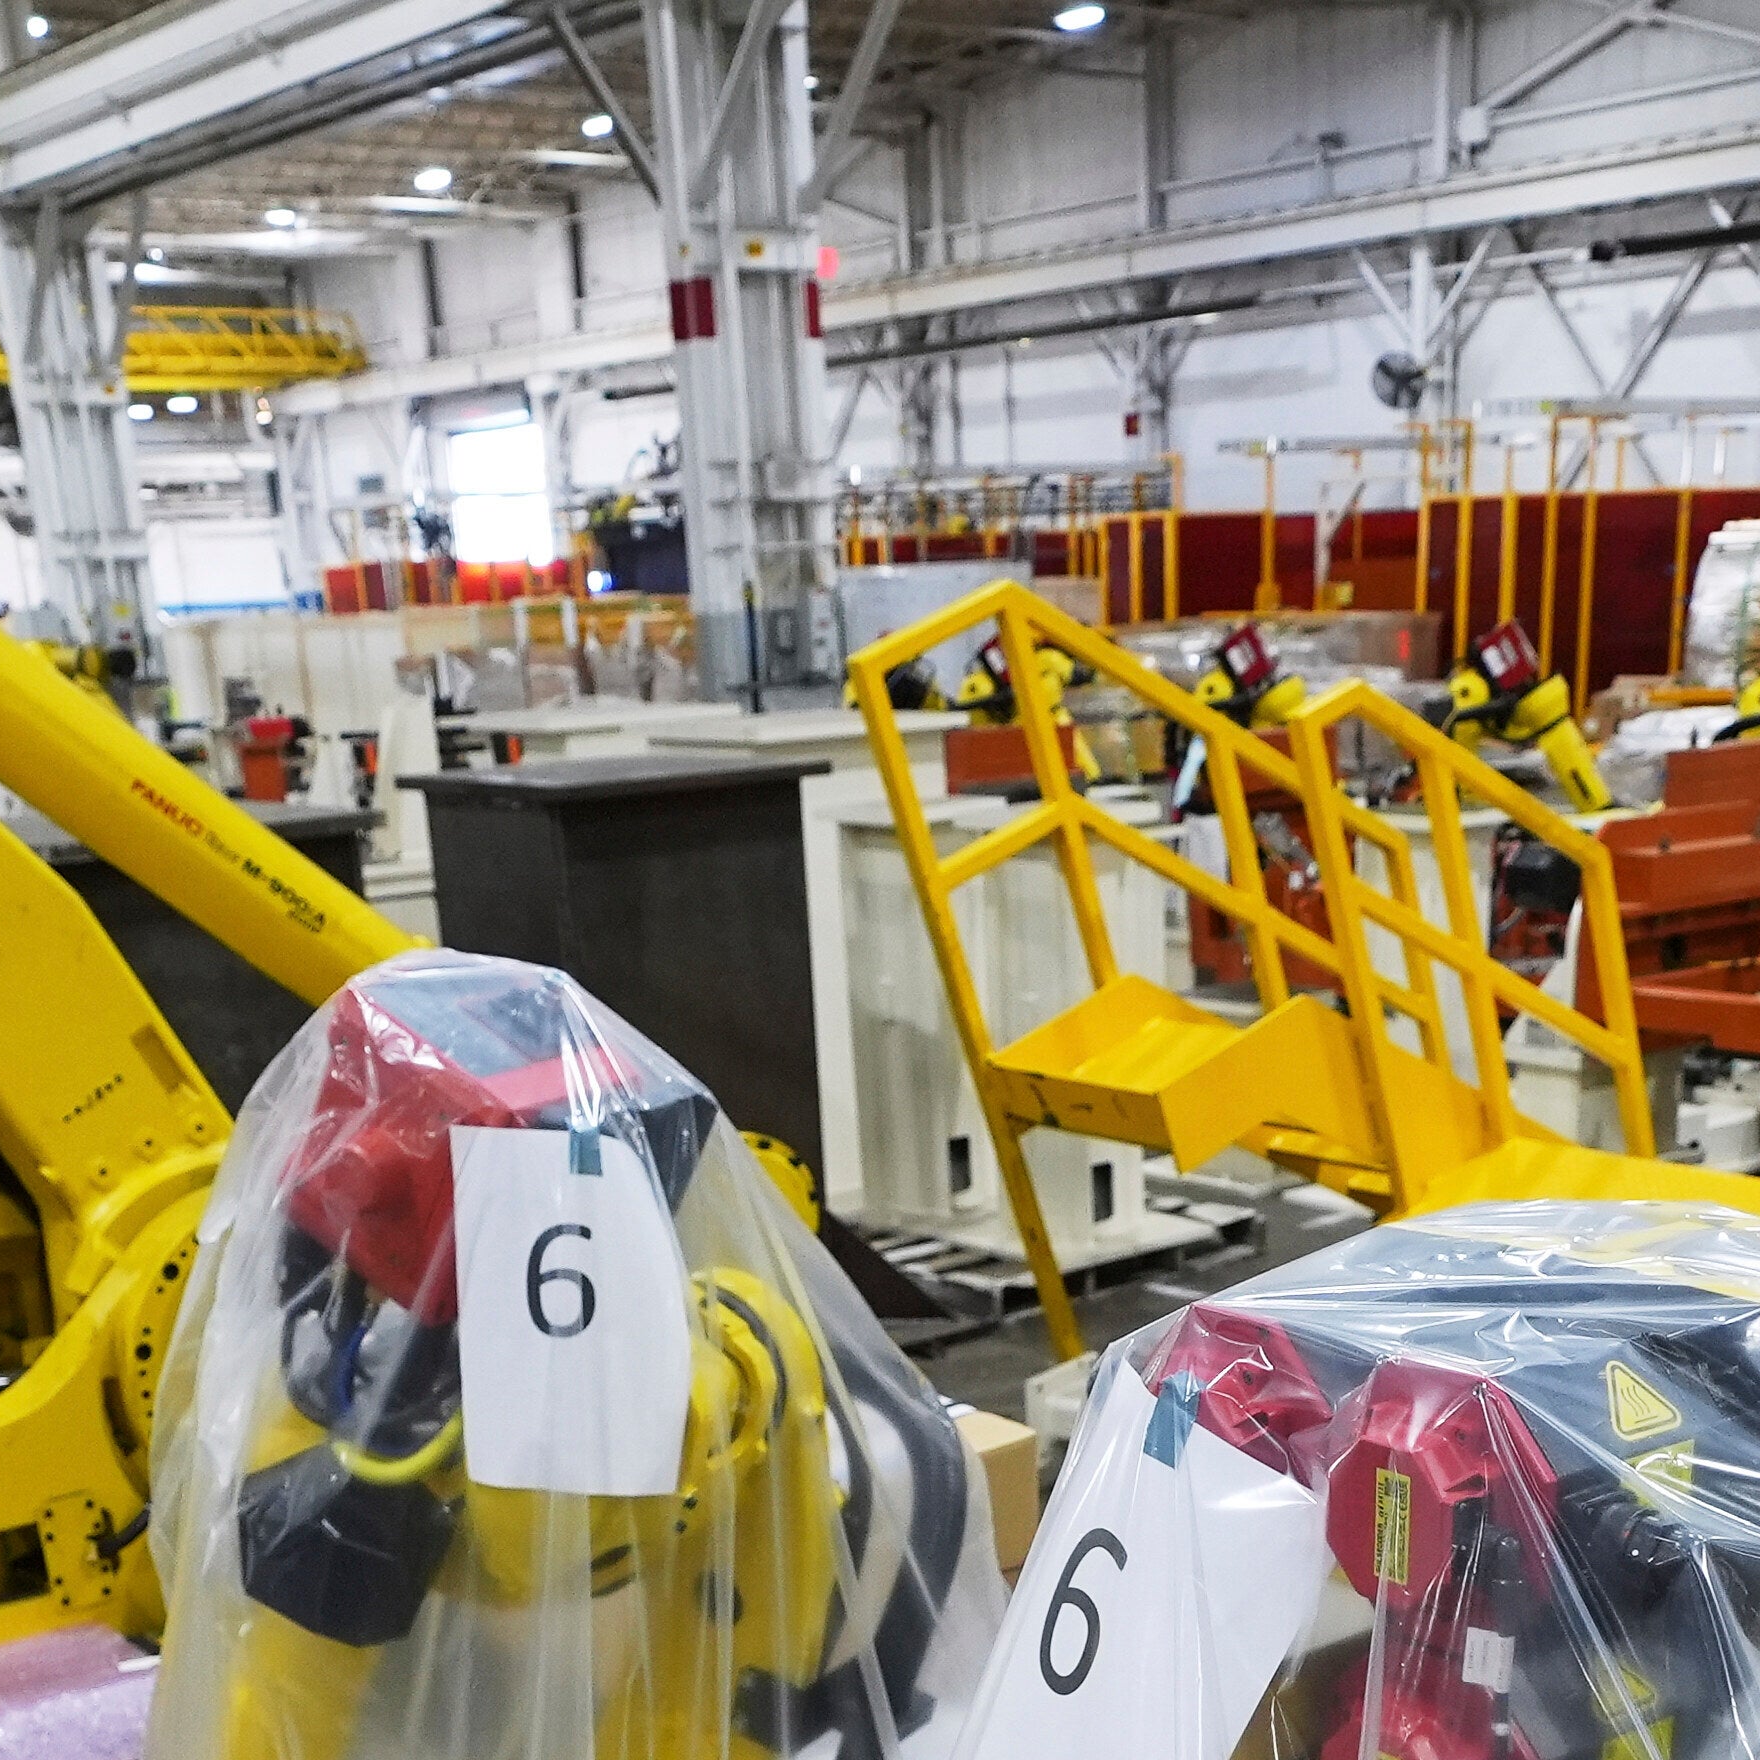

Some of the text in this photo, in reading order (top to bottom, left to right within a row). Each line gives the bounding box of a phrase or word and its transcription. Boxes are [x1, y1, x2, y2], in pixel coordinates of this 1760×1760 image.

[132, 779, 201, 835] FANUC
[526, 1223, 597, 1337] 6
[1039, 1527, 1128, 1695] 6
